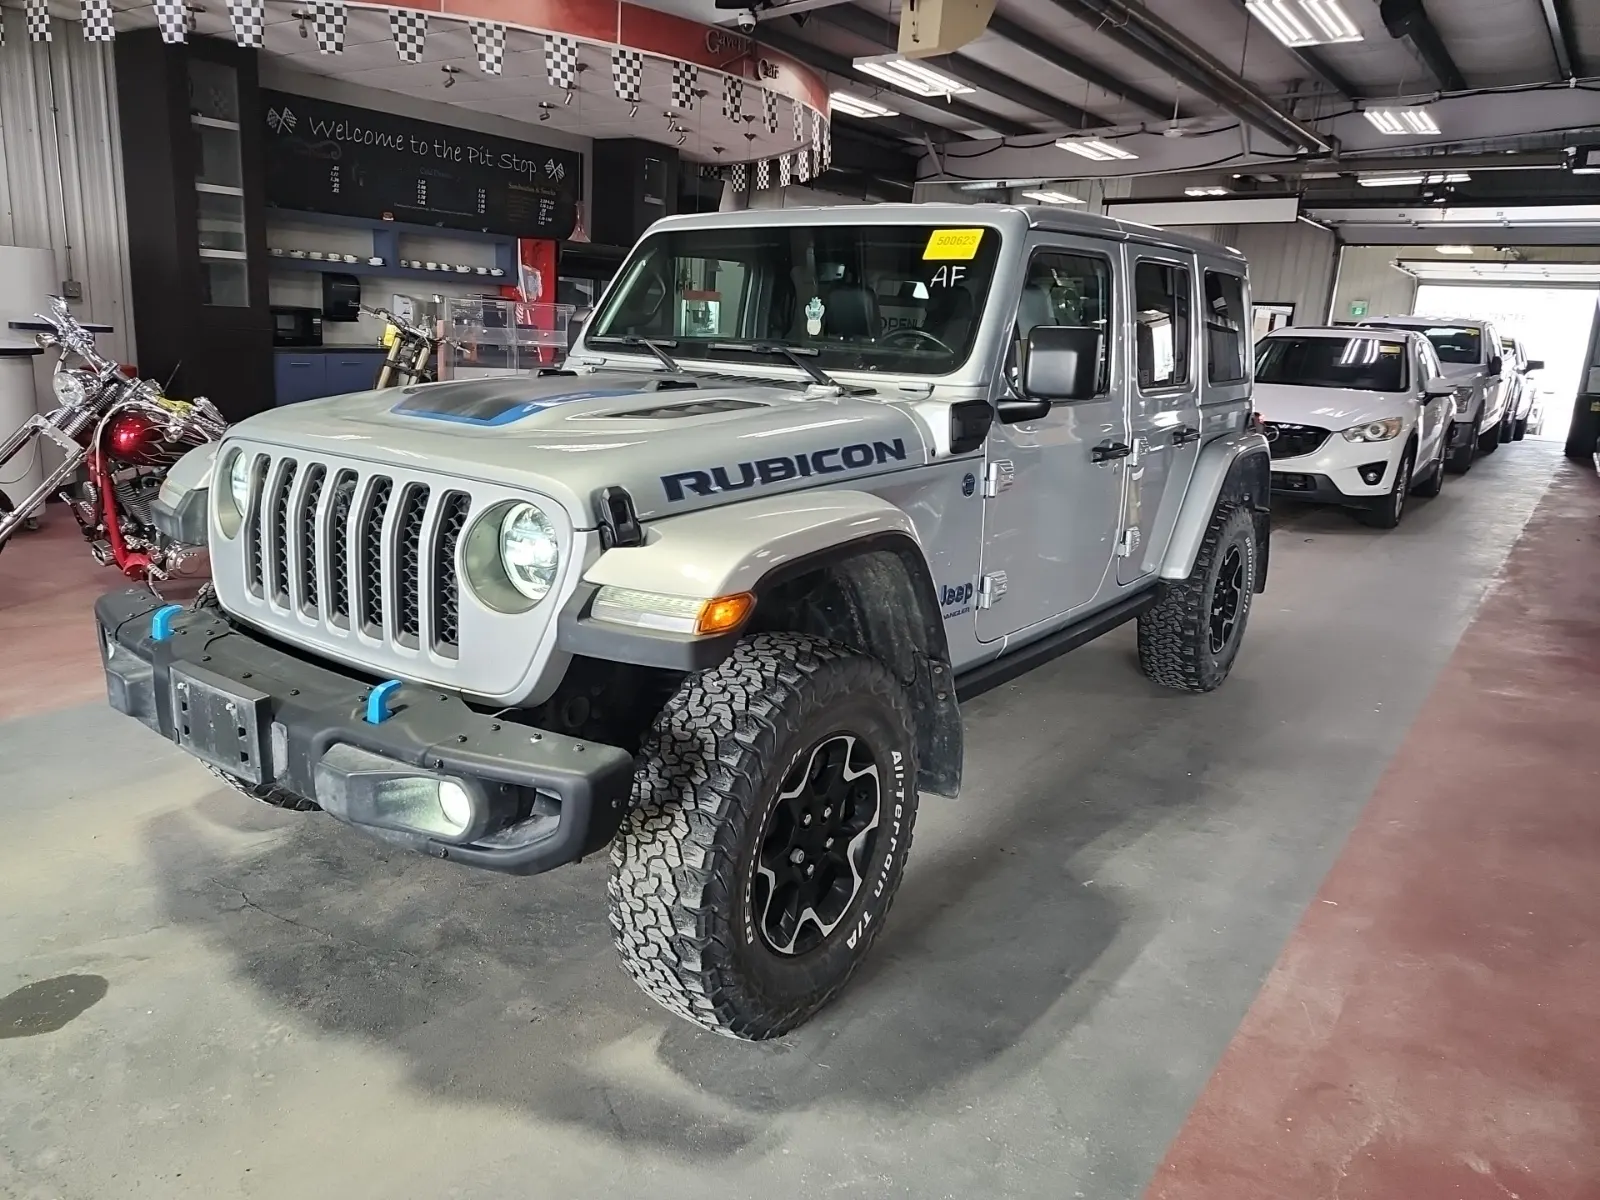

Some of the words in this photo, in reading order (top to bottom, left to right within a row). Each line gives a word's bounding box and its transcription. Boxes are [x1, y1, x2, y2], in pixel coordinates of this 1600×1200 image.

[309, 116, 404, 151] Welcome
[409, 135, 428, 156] to
[433, 139, 462, 162] the
[466, 146, 494, 167] Pit
[498, 153, 537, 182] Stop
[936, 235, 977, 246] 500623
[930, 265, 967, 288] AF
[659, 437, 907, 502] RUBICON
[939, 582, 974, 607] Jeep
[943, 606, 971, 620] ANGLER
[873, 750, 905, 898] All-Terrain
[845, 910, 874, 950] T/A
